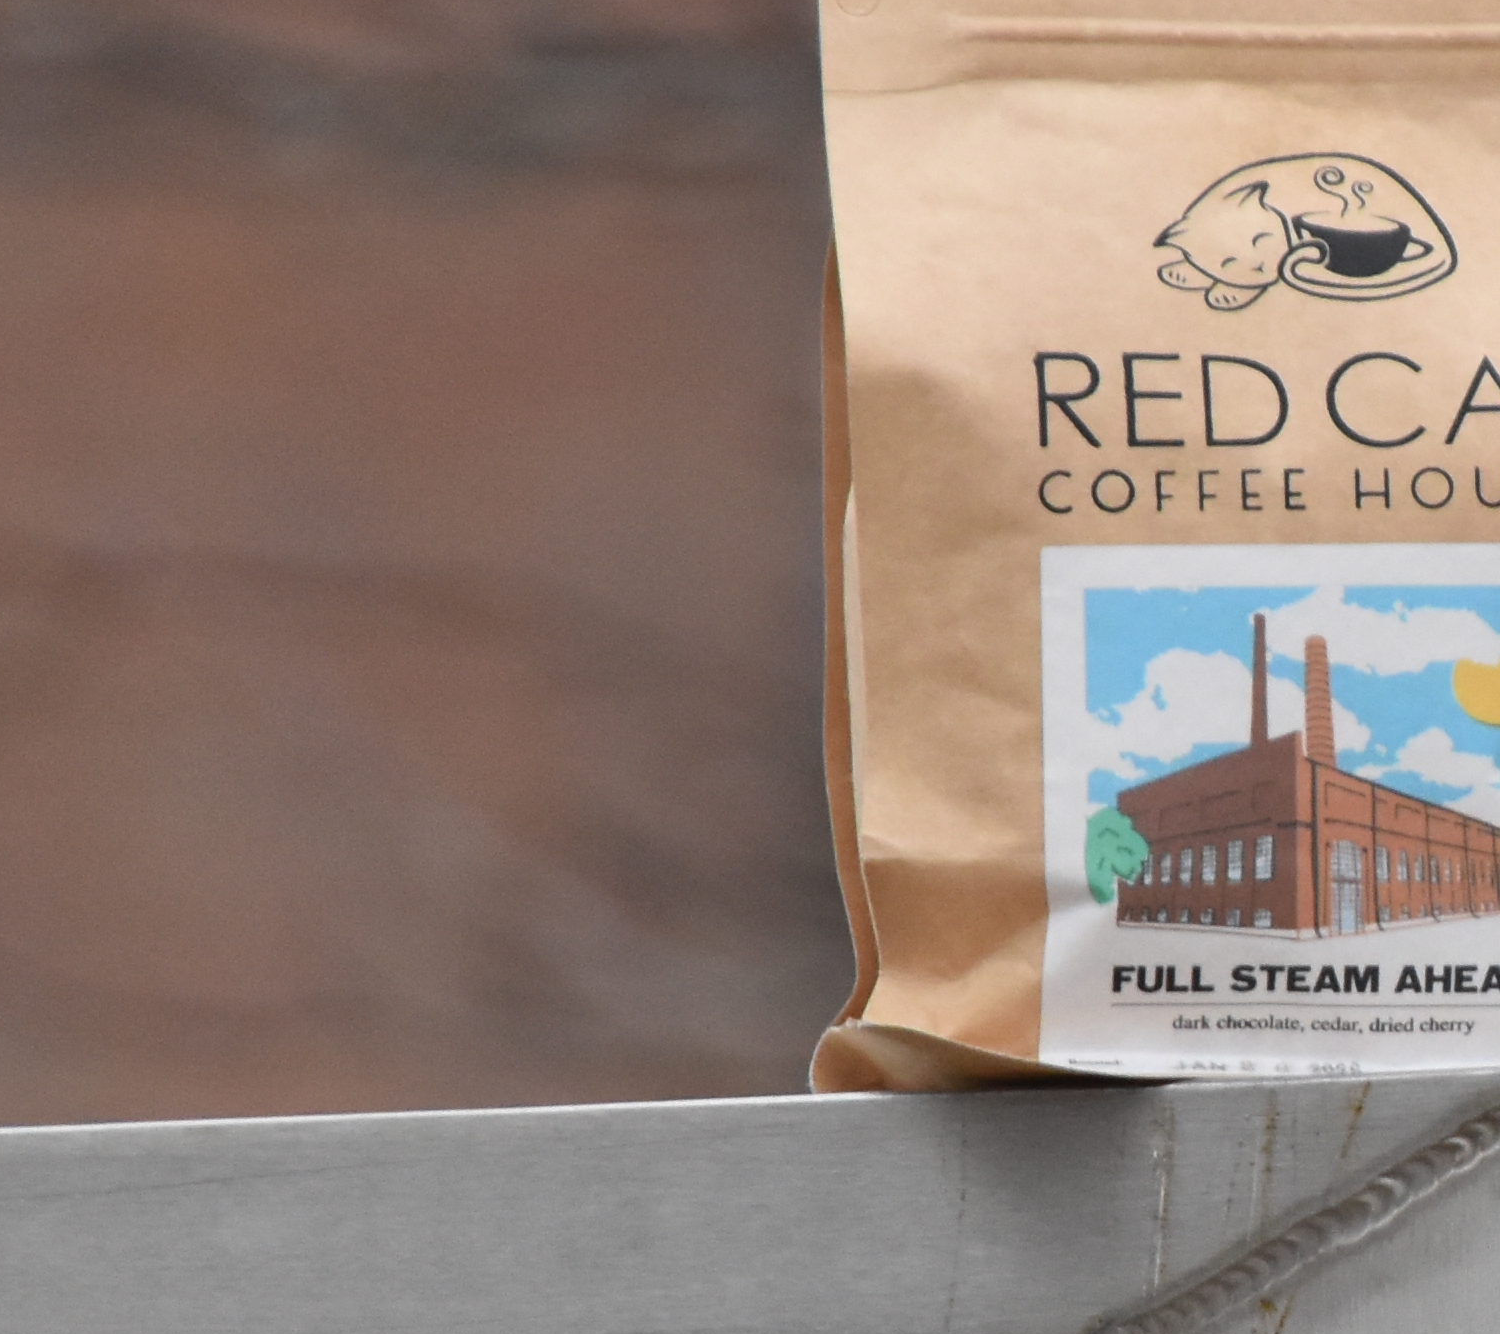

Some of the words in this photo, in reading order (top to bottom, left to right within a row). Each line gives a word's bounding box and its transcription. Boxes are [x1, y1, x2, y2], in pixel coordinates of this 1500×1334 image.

[1033, 352, 1290, 449] RED
[1038, 468, 1307, 515] COFFEE
[1111, 964, 1216, 994] FULL
[1230, 964, 1380, 994] STEAM
[1172, 1013, 1211, 1031] dark
[1216, 1013, 1304, 1034] chocolate,
[1311, 1015, 1363, 1035] cedar,
[1368, 1015, 1415, 1034] dried
[1419, 1016, 1475, 1036] cherry
